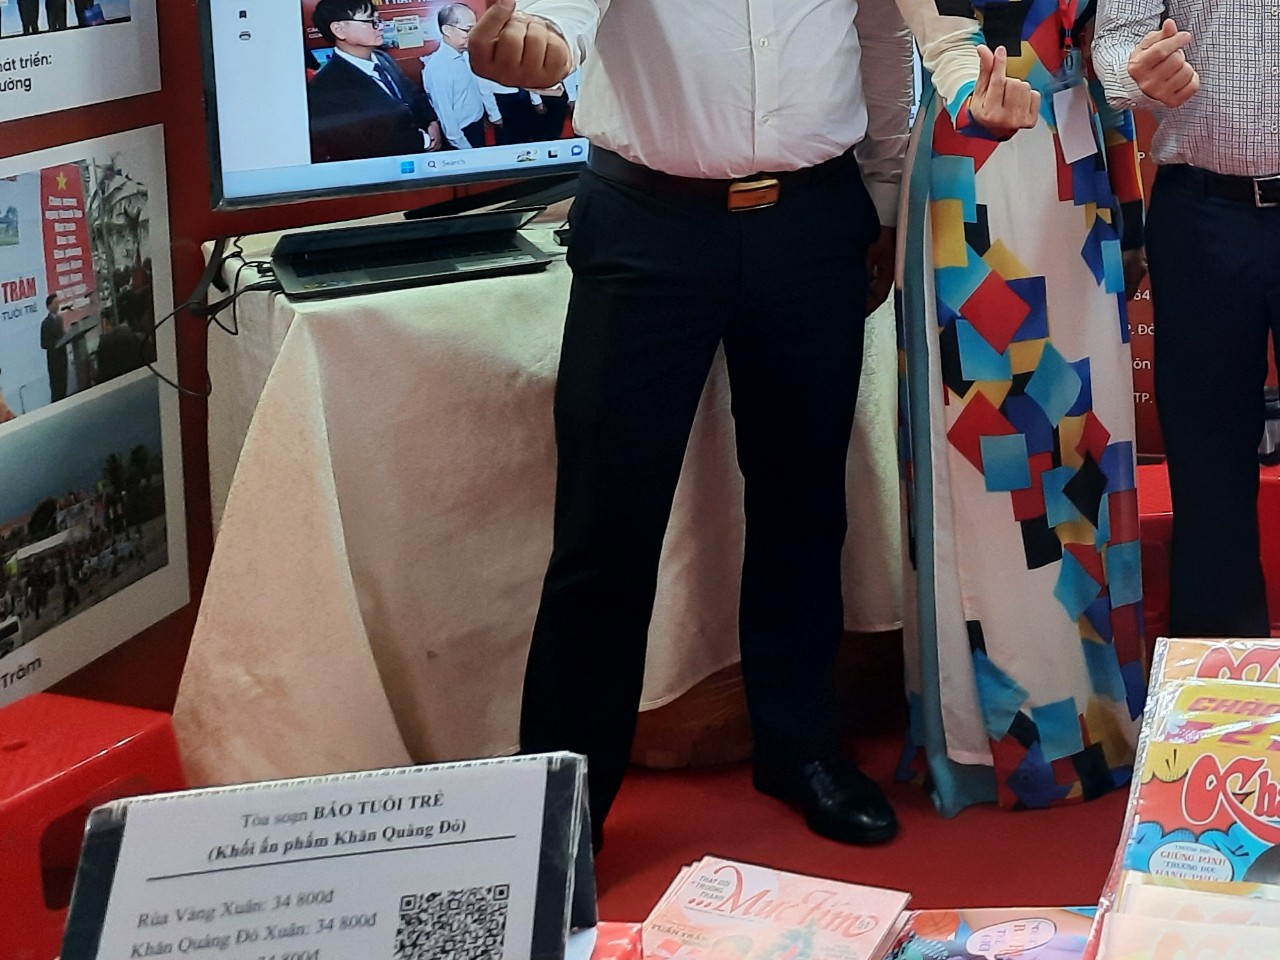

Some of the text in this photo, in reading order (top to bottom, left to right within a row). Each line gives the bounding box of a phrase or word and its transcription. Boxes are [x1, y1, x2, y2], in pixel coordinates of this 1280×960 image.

[1, 656, 42, 689] Trâm
[313, 800, 353, 820] BÁO
[358, 795, 403, 815] TUỔI
[408, 789, 445, 809] TRẺ
[207, 837, 255, 863] (Khối
[259, 836, 278, 854] ấn
[282, 831, 329, 855] phẩm
[333, 829, 377, 846] Khăn
[382, 823, 434, 841] Quàng
[272, 894, 292, 911] 34
[315, 917, 335, 934] 34
